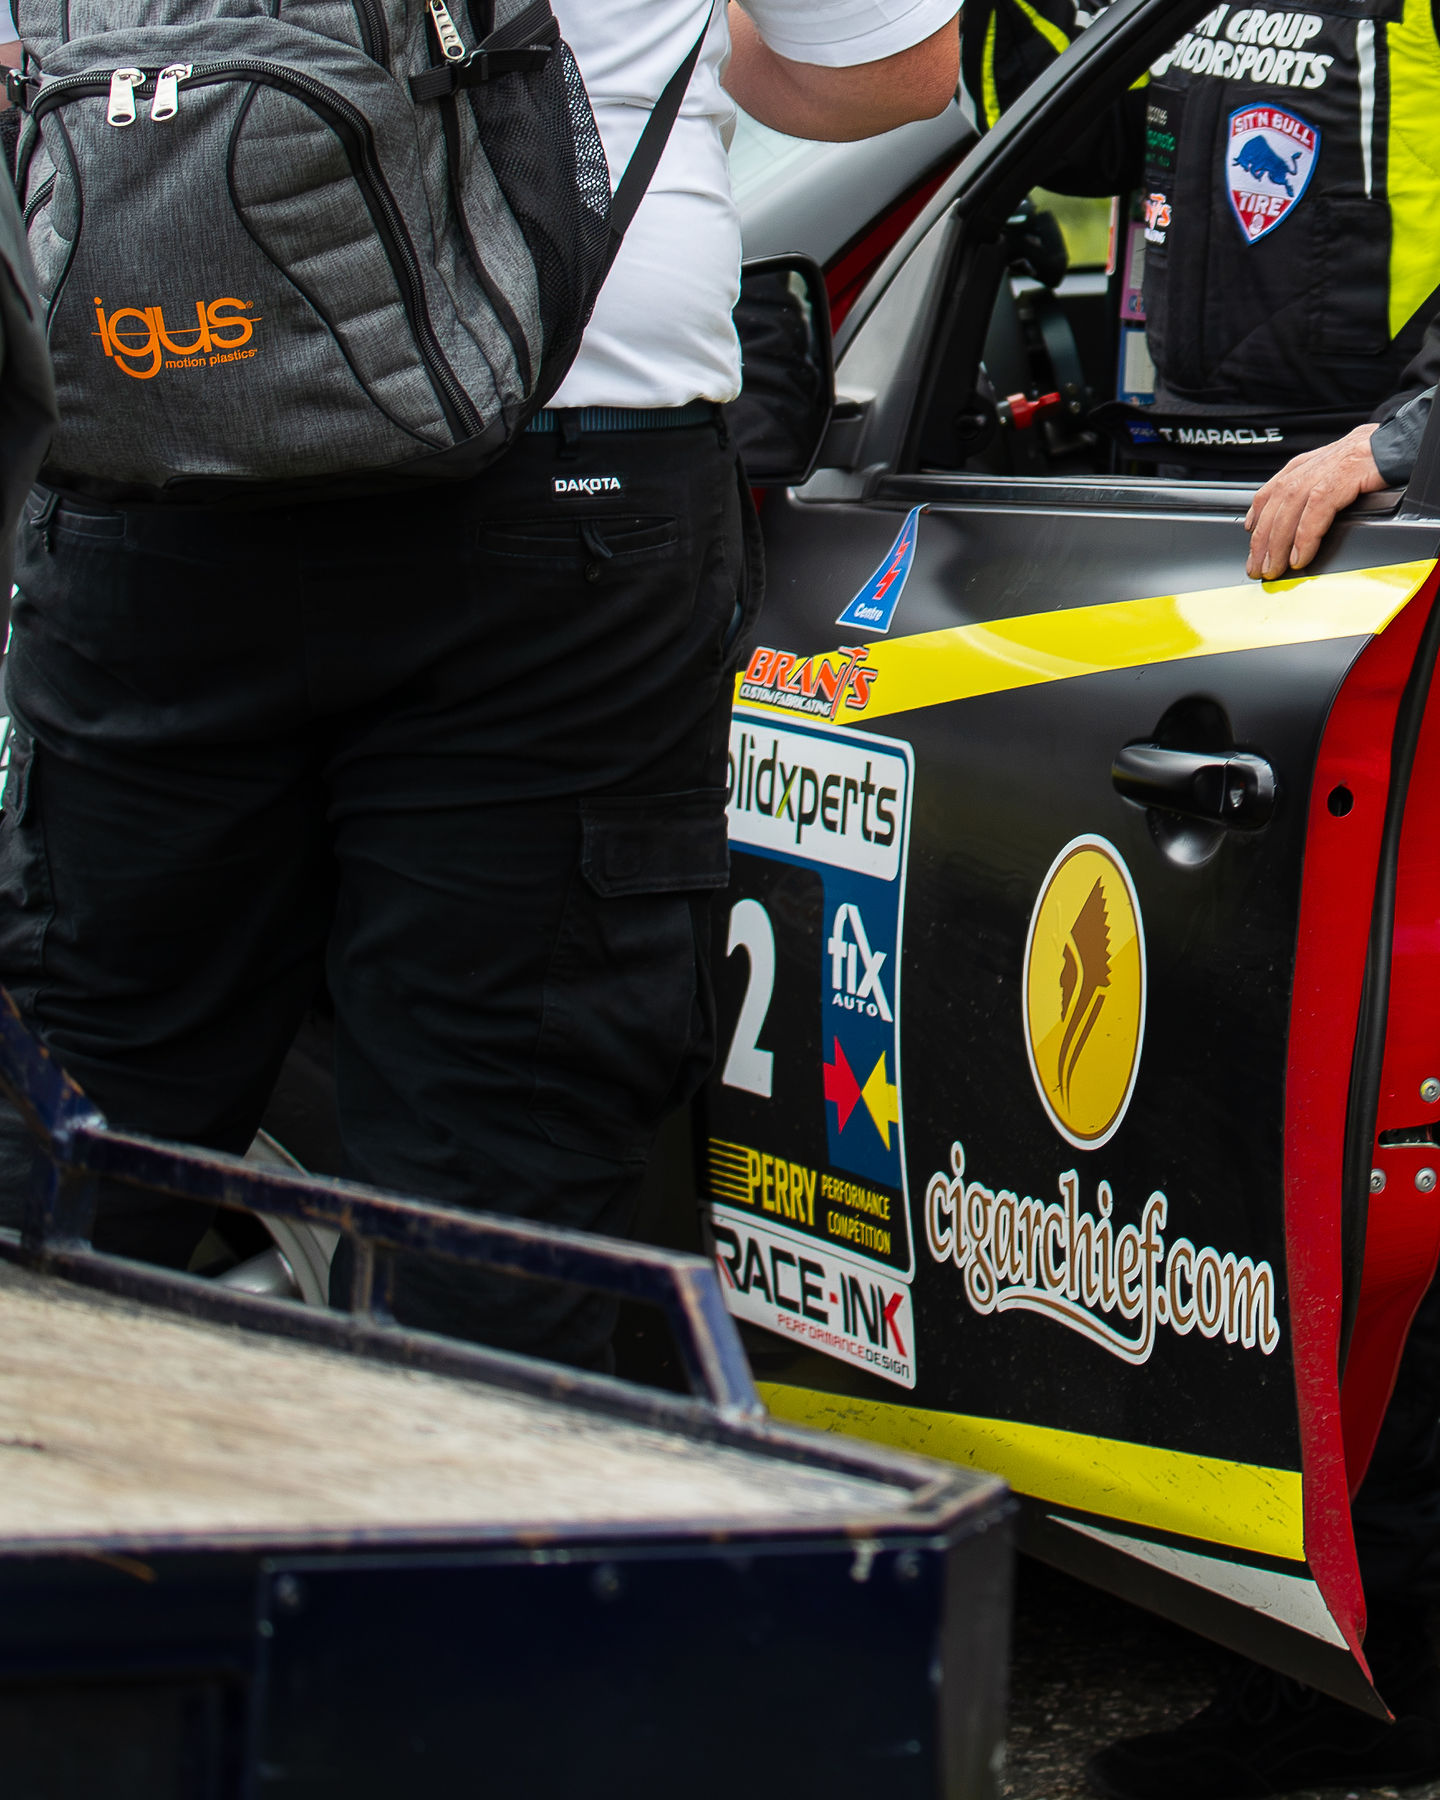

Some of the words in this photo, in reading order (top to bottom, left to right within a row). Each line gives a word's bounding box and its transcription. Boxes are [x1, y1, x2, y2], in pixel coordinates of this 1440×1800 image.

[1271, 113, 1312, 146] BULL
[1239, 191, 1285, 217] TIRE
[93, 296, 254, 380] igus
[165, 356, 207, 369] motion
[209, 350, 257, 367] plastics
[555, 477, 621, 495] DAKOTA
[853, 602, 884, 622] Centre
[739, 683, 776, 704] CUSTOM
[773, 688, 832, 716] FABRICATING
[831, 992, 879, 1017] AUTO
[747, 1148, 818, 1227] PERRY
[821, 1173, 891, 1221] PERFORMANCE
[827, 1210, 891, 1255] COMPÉTITION
[925, 1140, 1281, 1365] cigarchief.com
